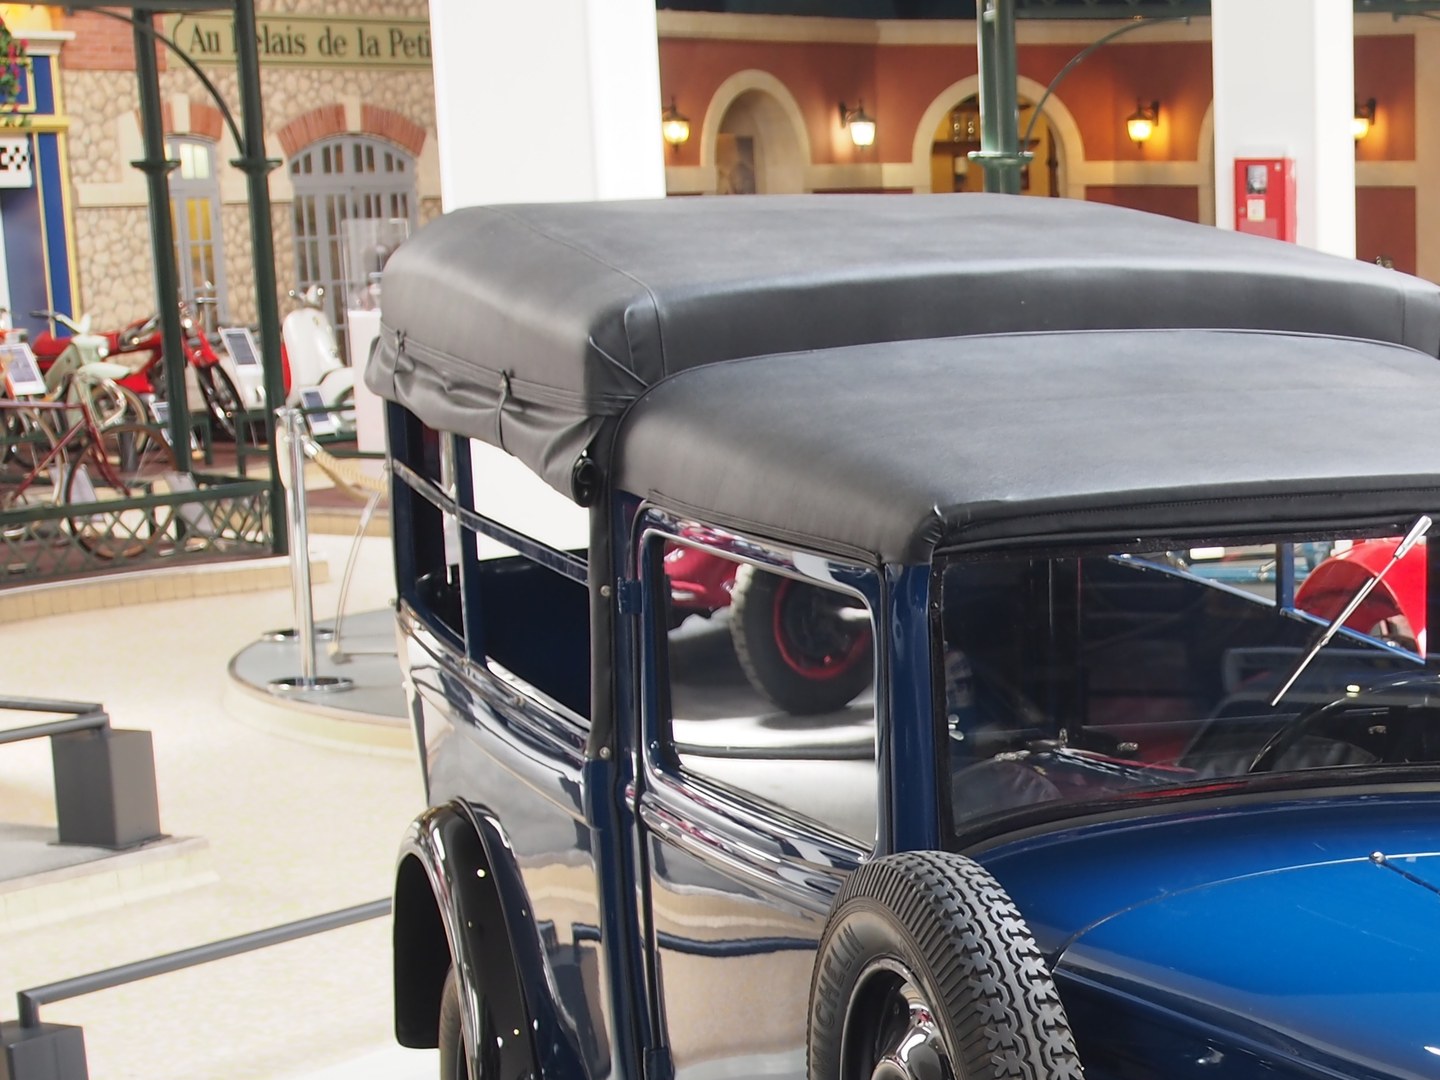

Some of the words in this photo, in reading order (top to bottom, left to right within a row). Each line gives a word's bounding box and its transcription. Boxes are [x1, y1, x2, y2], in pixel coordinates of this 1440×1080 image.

[190, 24, 220, 52] Au
[232, 24, 306, 57] lais
[317, 26, 347, 57] de
[357, 27, 380, 57] la
[812, 922, 864, 1075] MICHELIN
